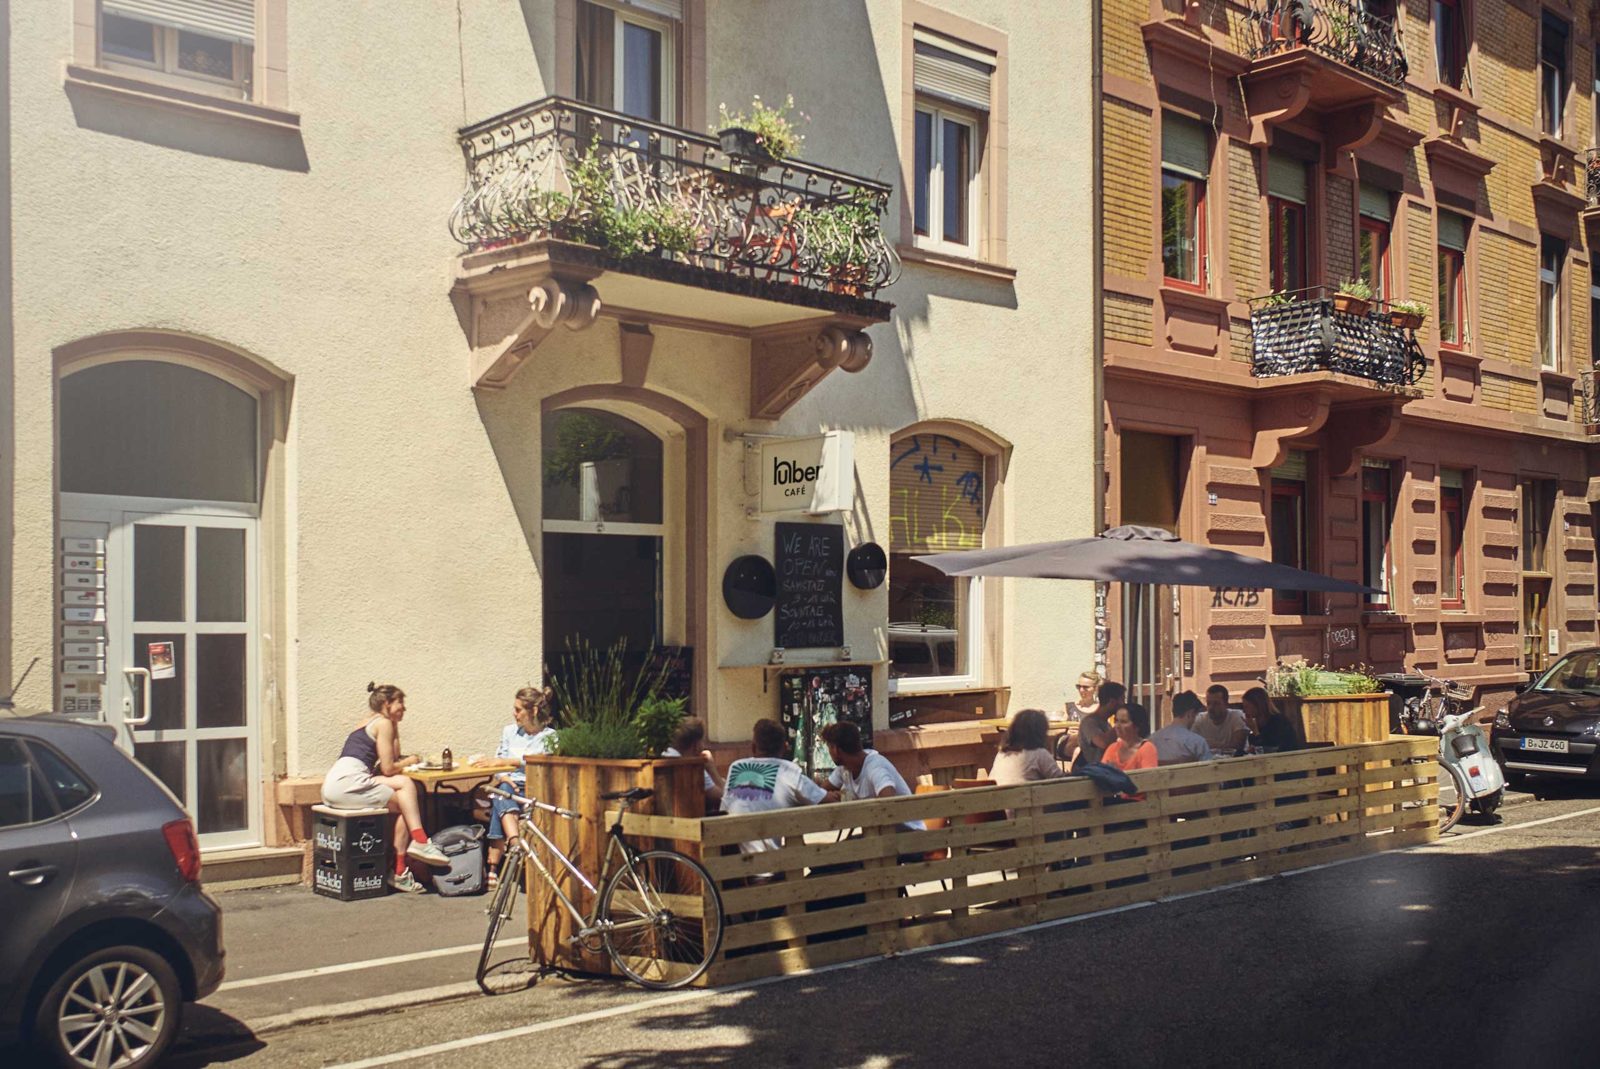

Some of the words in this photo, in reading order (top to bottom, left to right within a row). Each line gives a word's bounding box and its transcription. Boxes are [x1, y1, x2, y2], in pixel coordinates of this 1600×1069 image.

[773, 456, 824, 485] huber
[784, 485, 806, 497] CAFÉ
[783, 531, 802, 554] WE
[808, 535, 831, 557] ARE
[783, 558, 828, 576] OPEN
[1211, 586, 1260, 607] ACAB
[1528, 739, 1534, 748] B
[1538, 740, 1549, 749] JZ
[1550, 741, 1565, 750] 460
